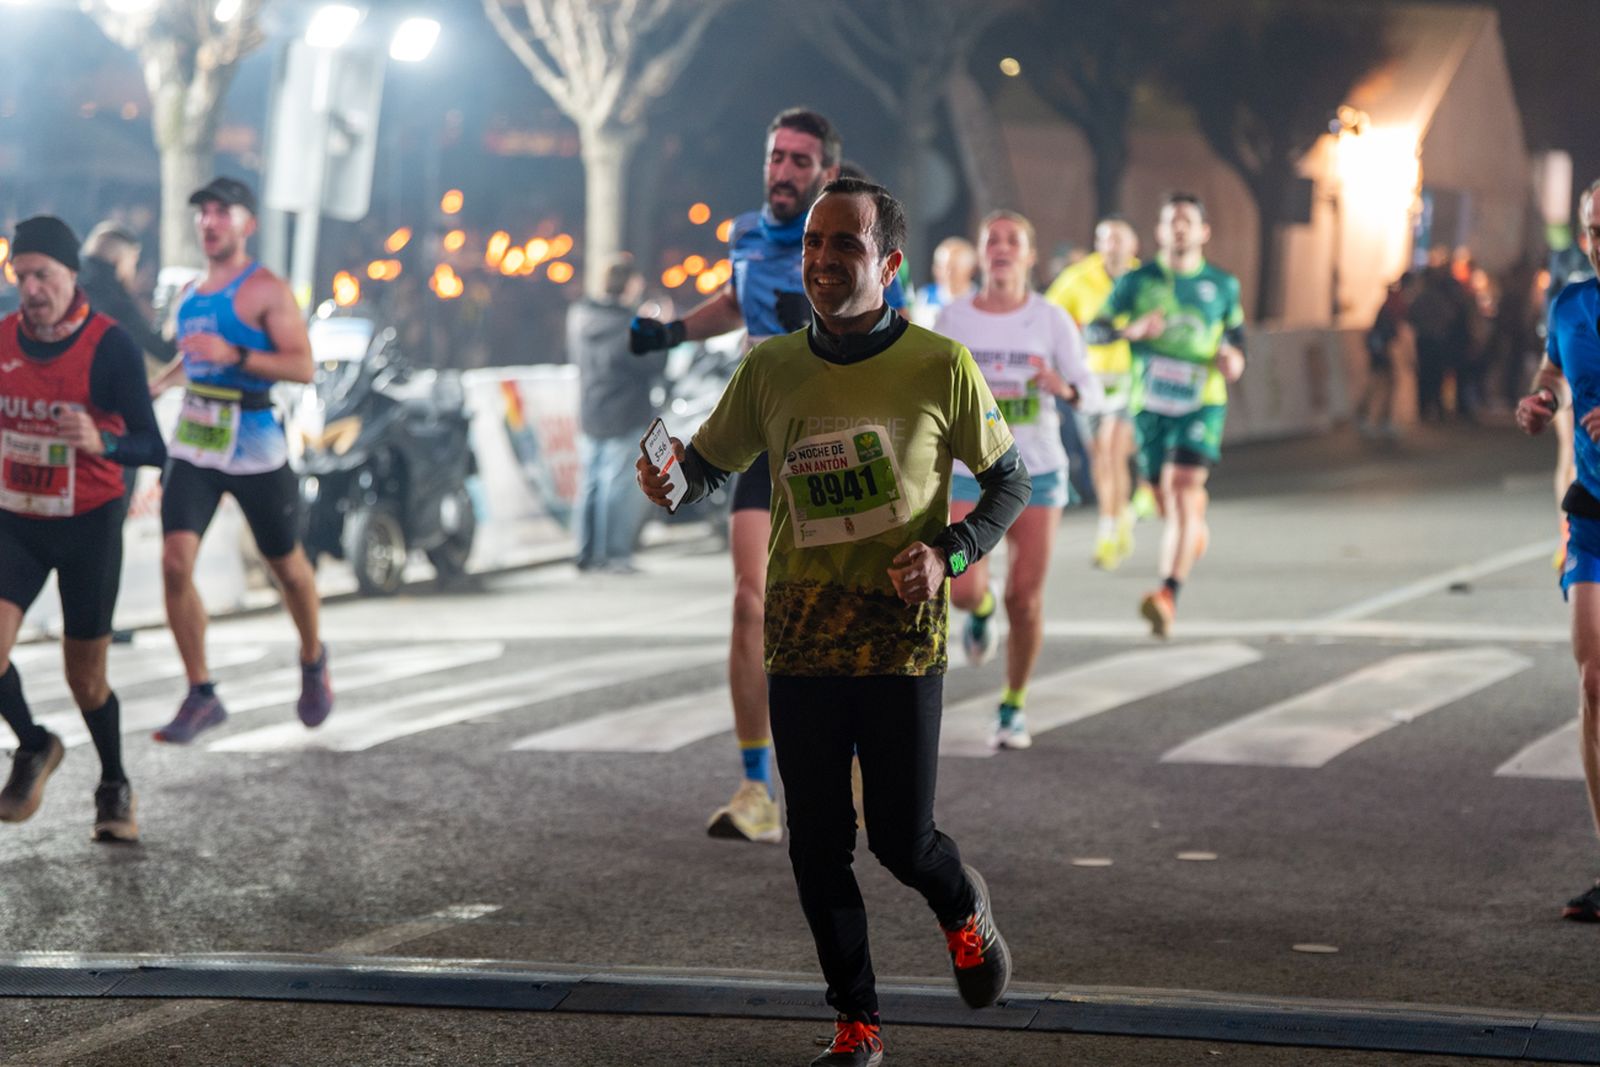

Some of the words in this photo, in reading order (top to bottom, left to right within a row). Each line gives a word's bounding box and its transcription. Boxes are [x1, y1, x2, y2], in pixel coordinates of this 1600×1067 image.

[0, 396, 65, 421] ULSO
[798, 446, 830, 460] NOCHE
[831, 444, 845, 455] DE
[790, 460, 813, 475] SAN
[807, 465, 878, 507] 8941
